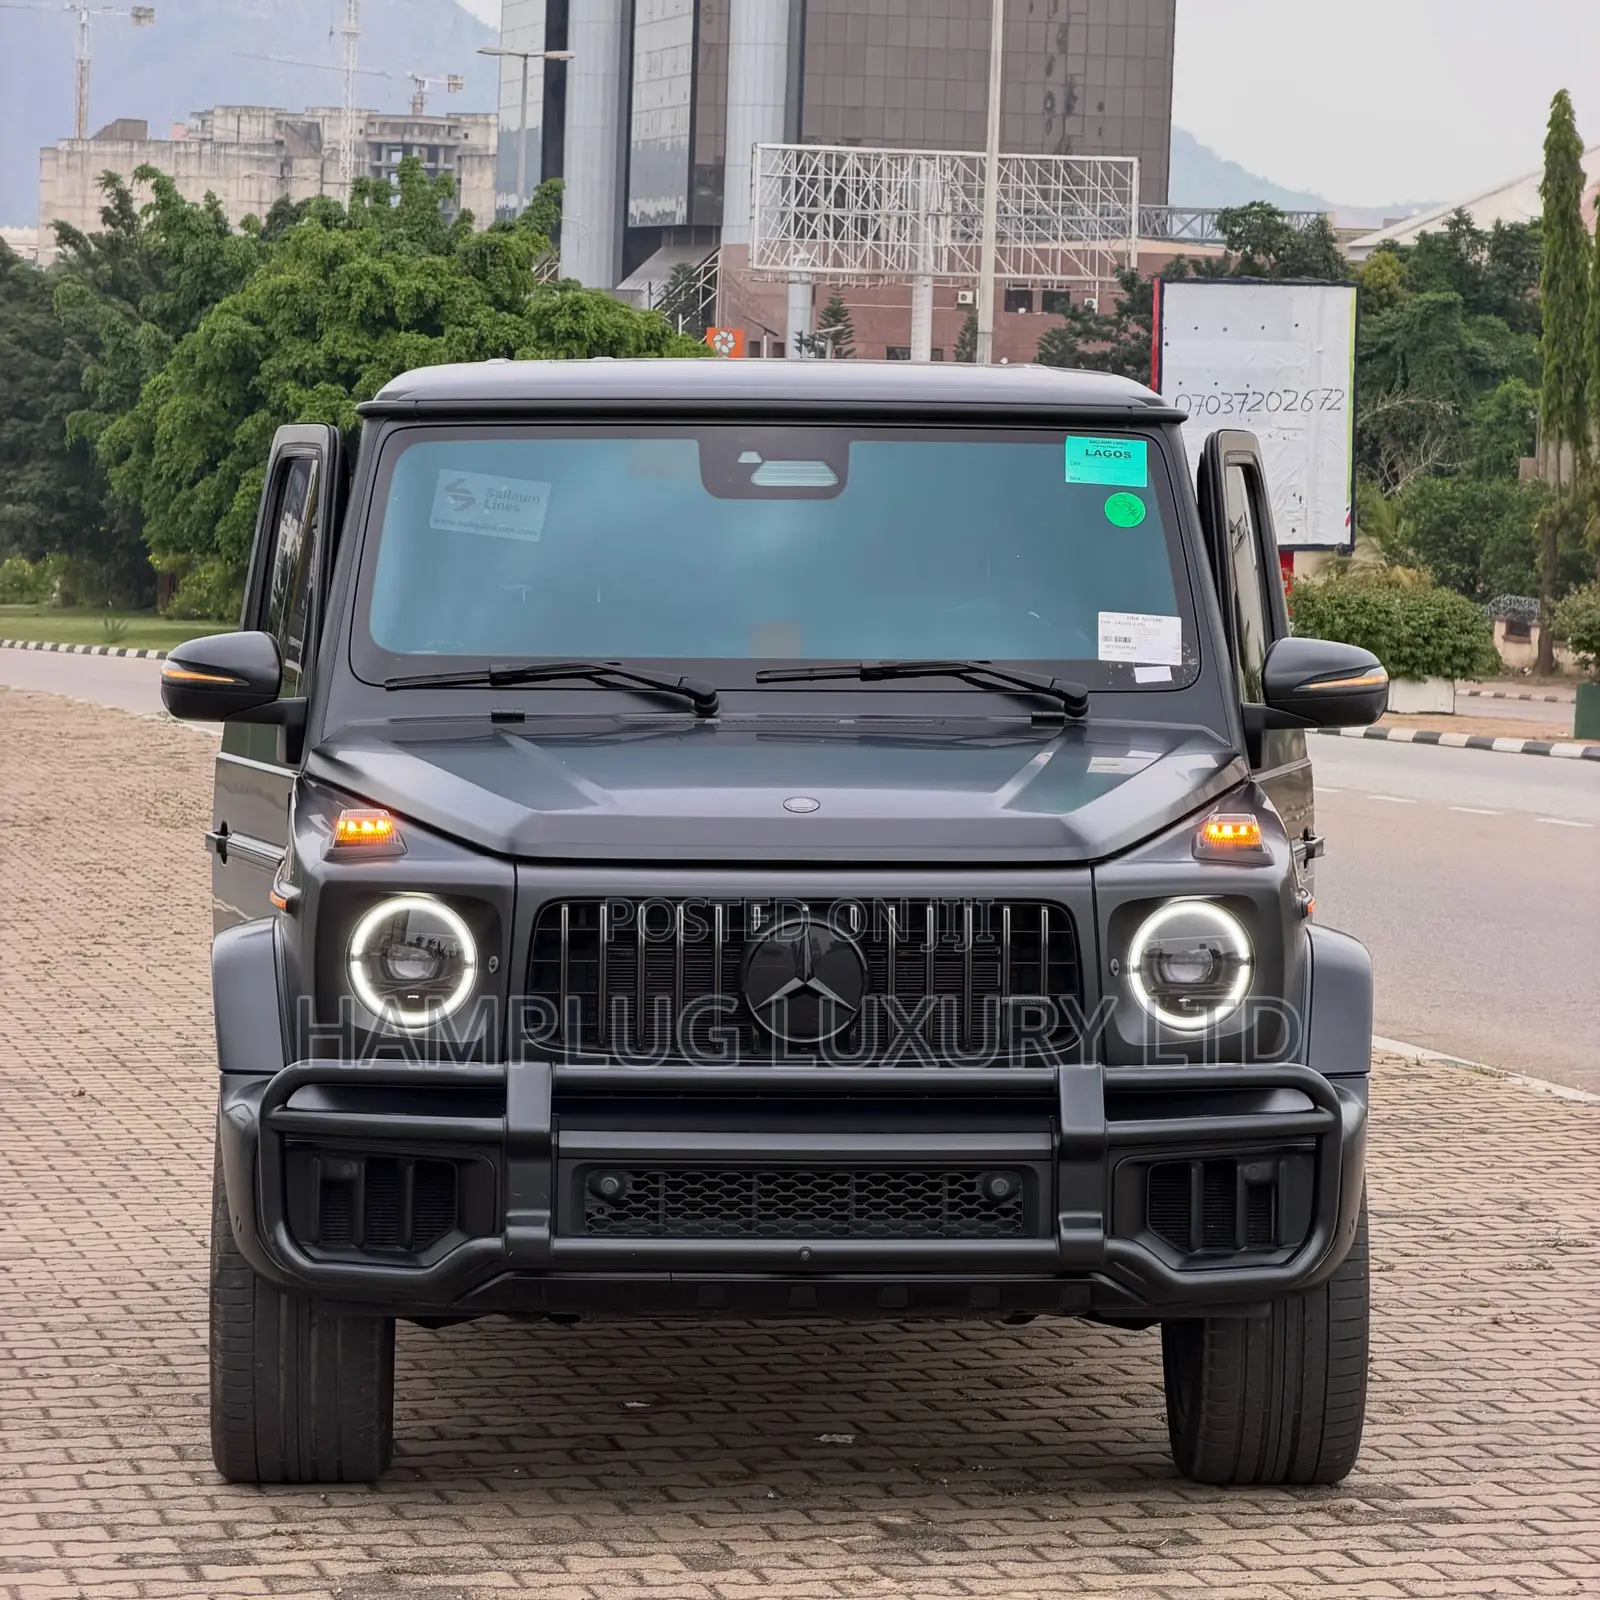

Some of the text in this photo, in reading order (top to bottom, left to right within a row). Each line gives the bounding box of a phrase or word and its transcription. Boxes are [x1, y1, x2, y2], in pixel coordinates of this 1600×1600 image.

[1175, 388, 1345, 416] 07037202672
[1085, 448, 1132, 459] LAGOS
[485, 487, 540, 504] Sallaum
[483, 499, 521, 513] Lines
